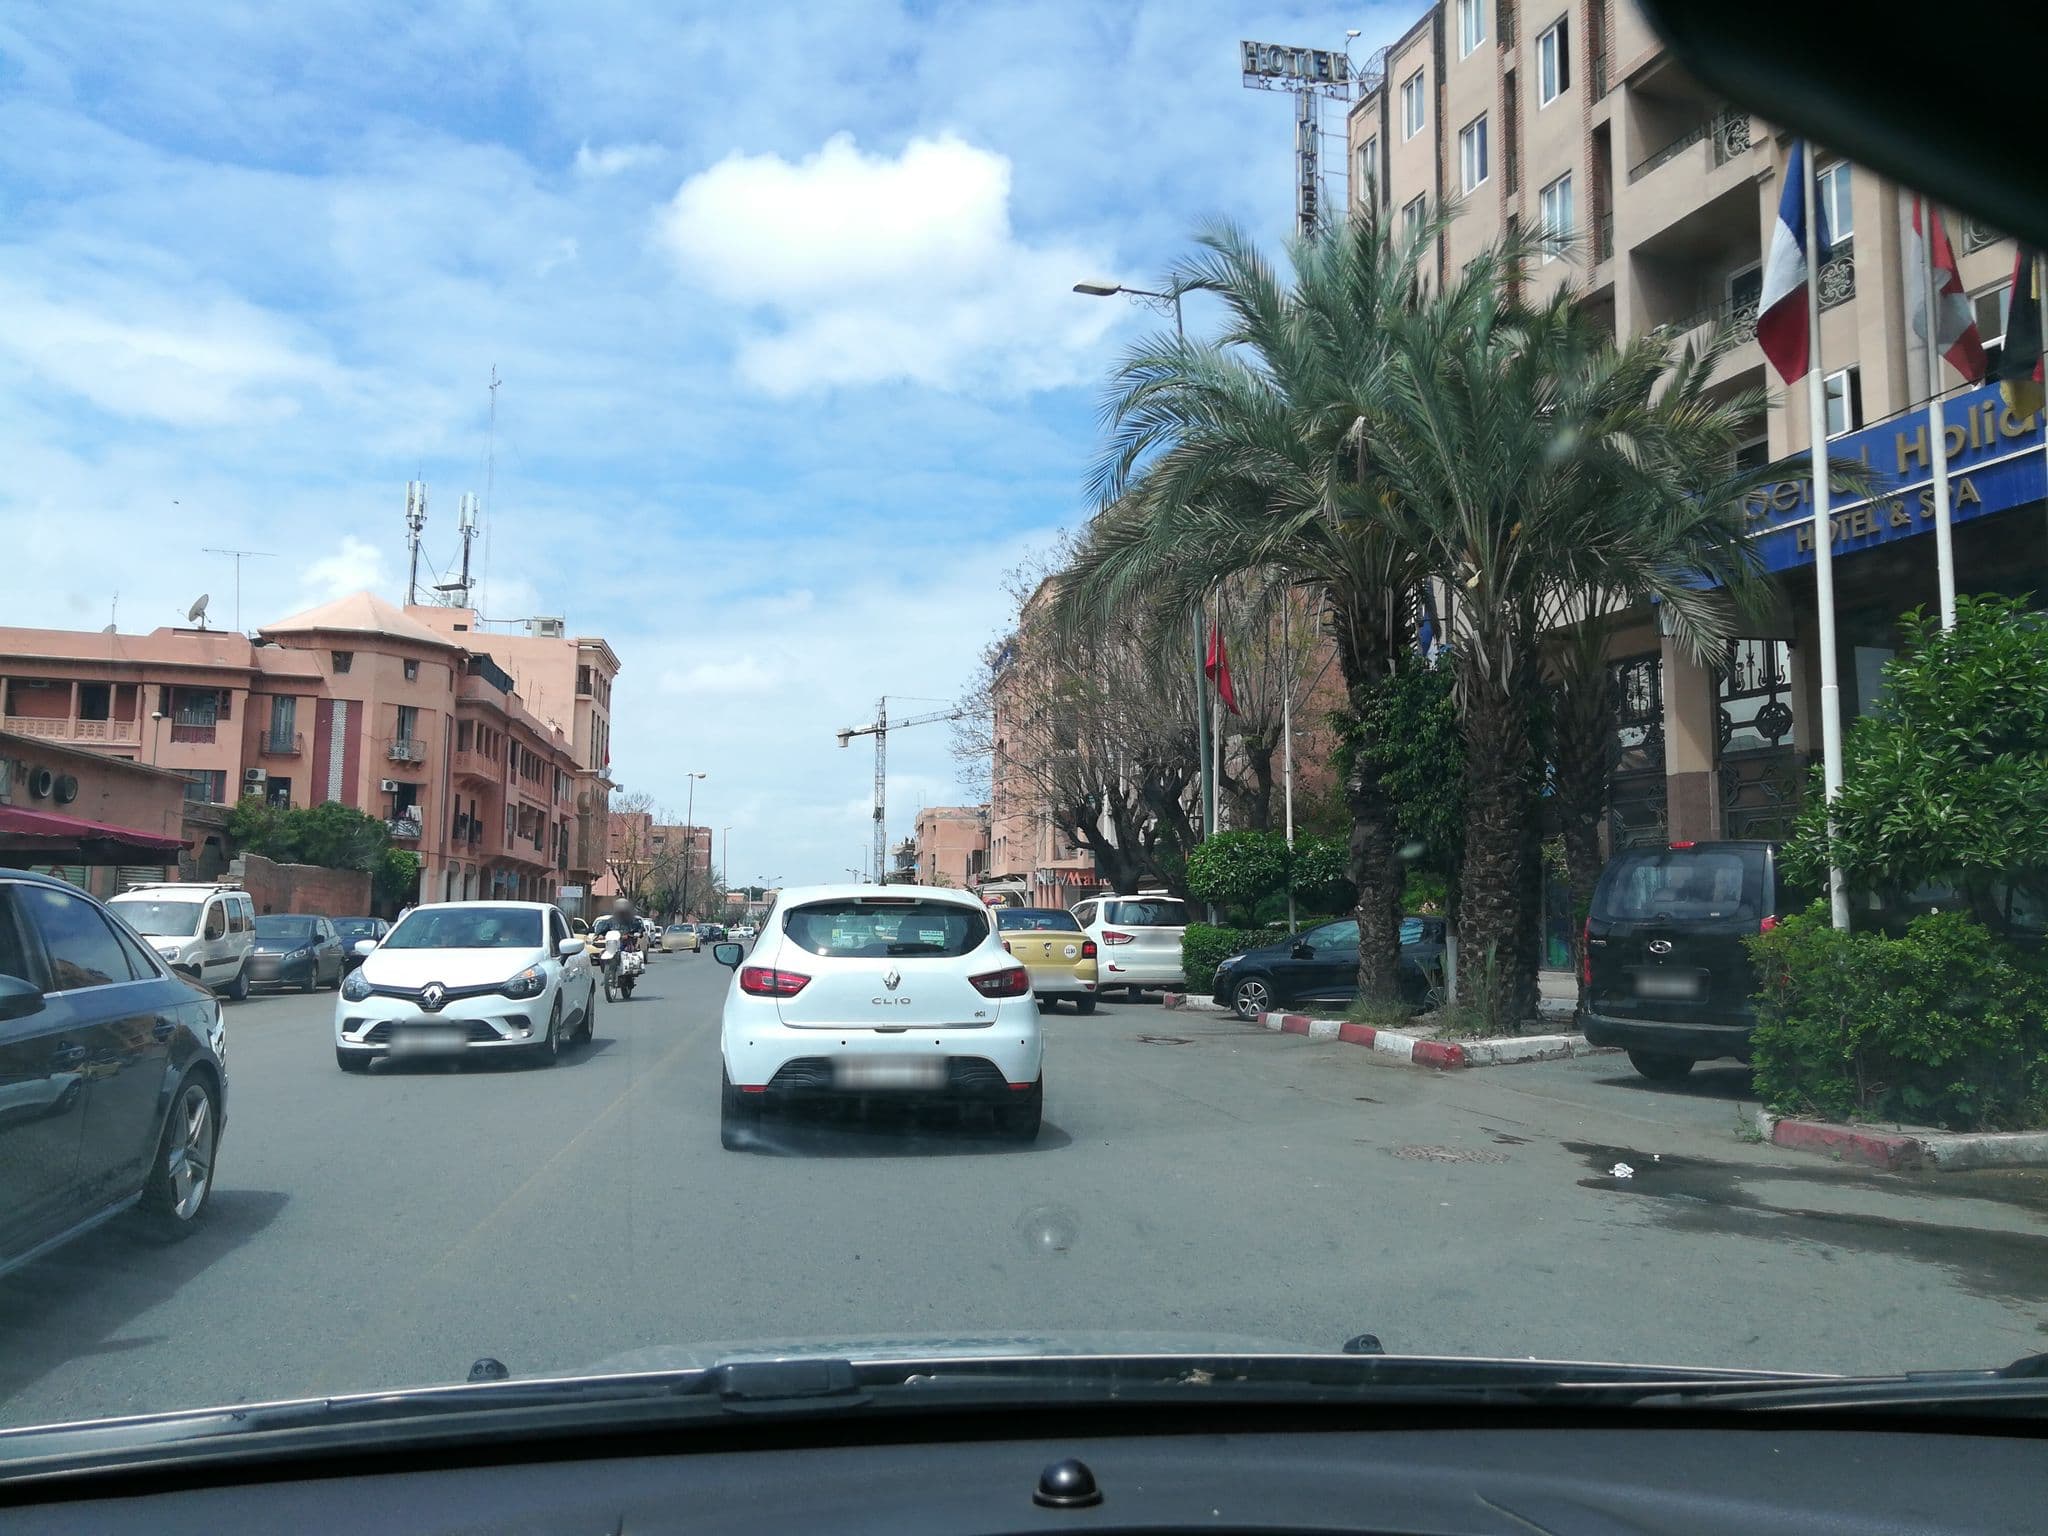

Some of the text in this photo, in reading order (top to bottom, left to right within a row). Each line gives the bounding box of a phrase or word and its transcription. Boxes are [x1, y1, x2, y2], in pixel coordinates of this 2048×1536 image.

[1240, 40, 1348, 82] HOTEL
[1889, 498, 1911, 528] &
[1919, 477, 1981, 518] SA
[871, 997, 911, 1005] CLIO
